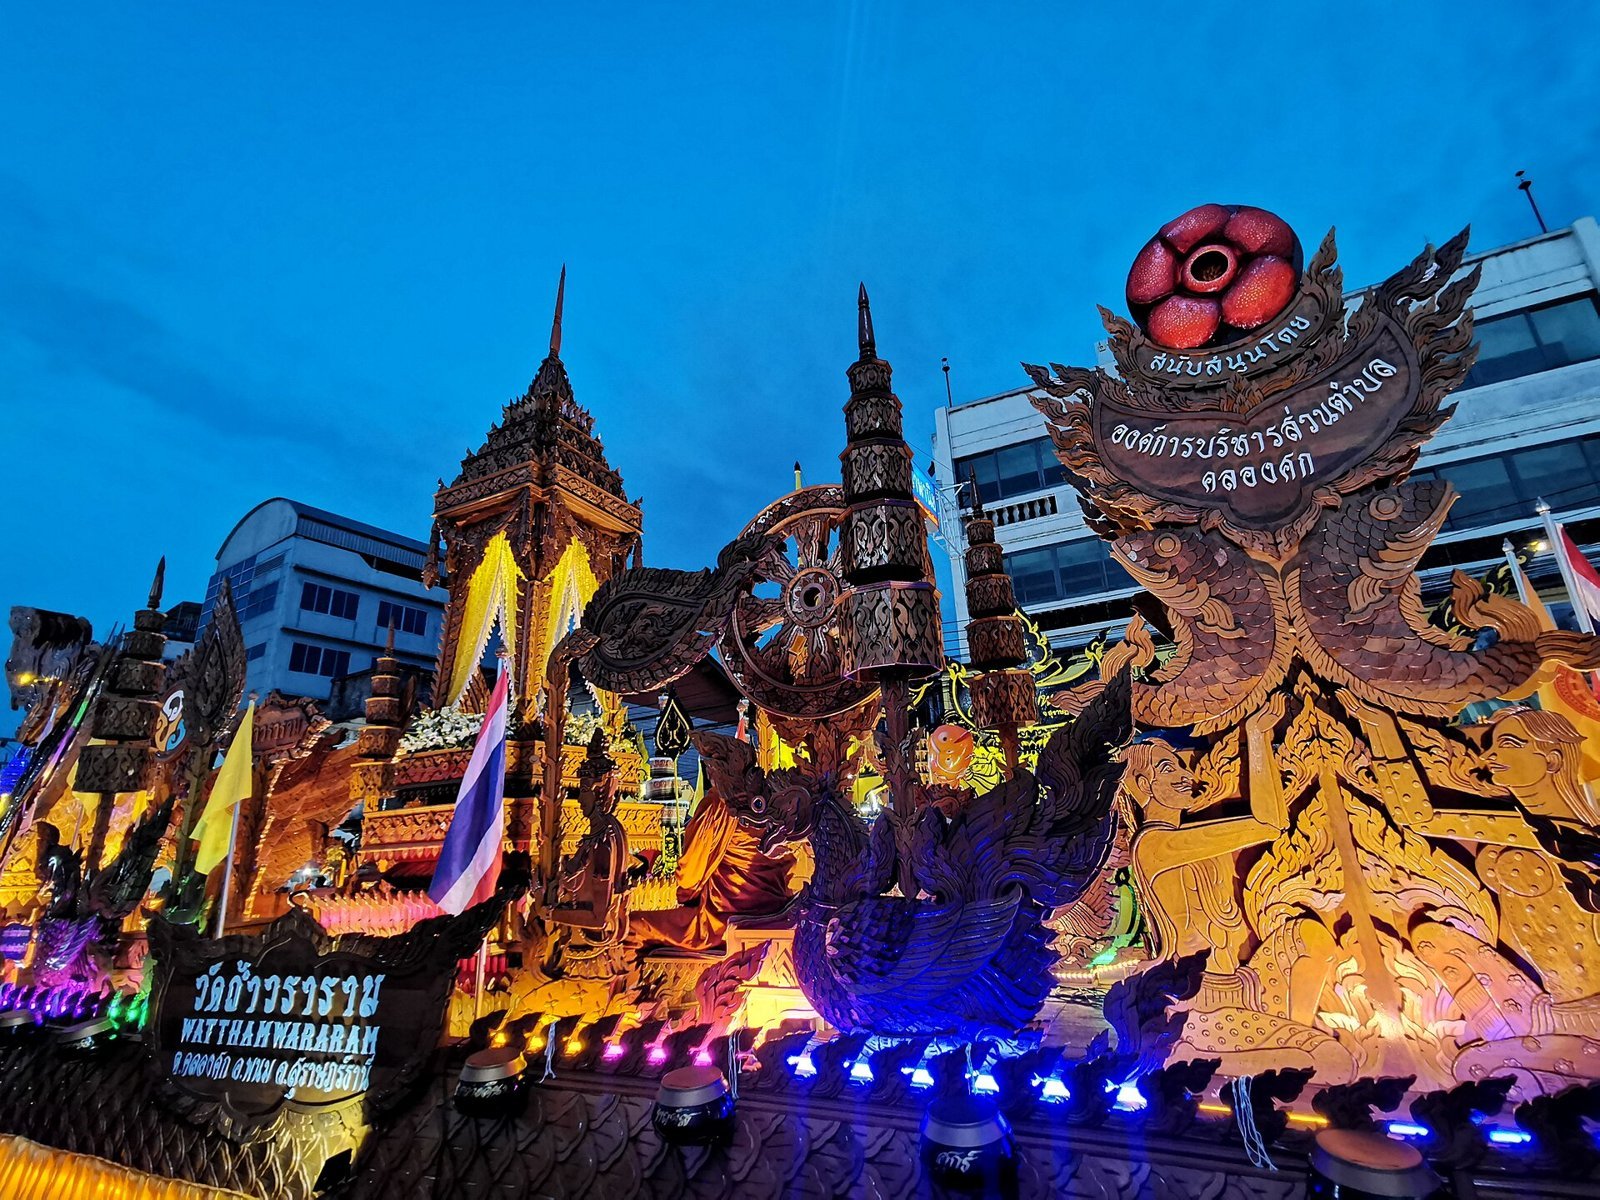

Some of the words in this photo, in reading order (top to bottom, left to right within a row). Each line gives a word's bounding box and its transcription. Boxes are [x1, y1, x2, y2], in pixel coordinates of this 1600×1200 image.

[1150, 315, 1311, 376] สนับสนุนโดย
[1111, 358, 1397, 459] องค์การบริหารส่วนตำบล
[1201, 451, 1315, 493] คลองศก
[193, 959, 386, 1018] วัดถ้ำวราราม
